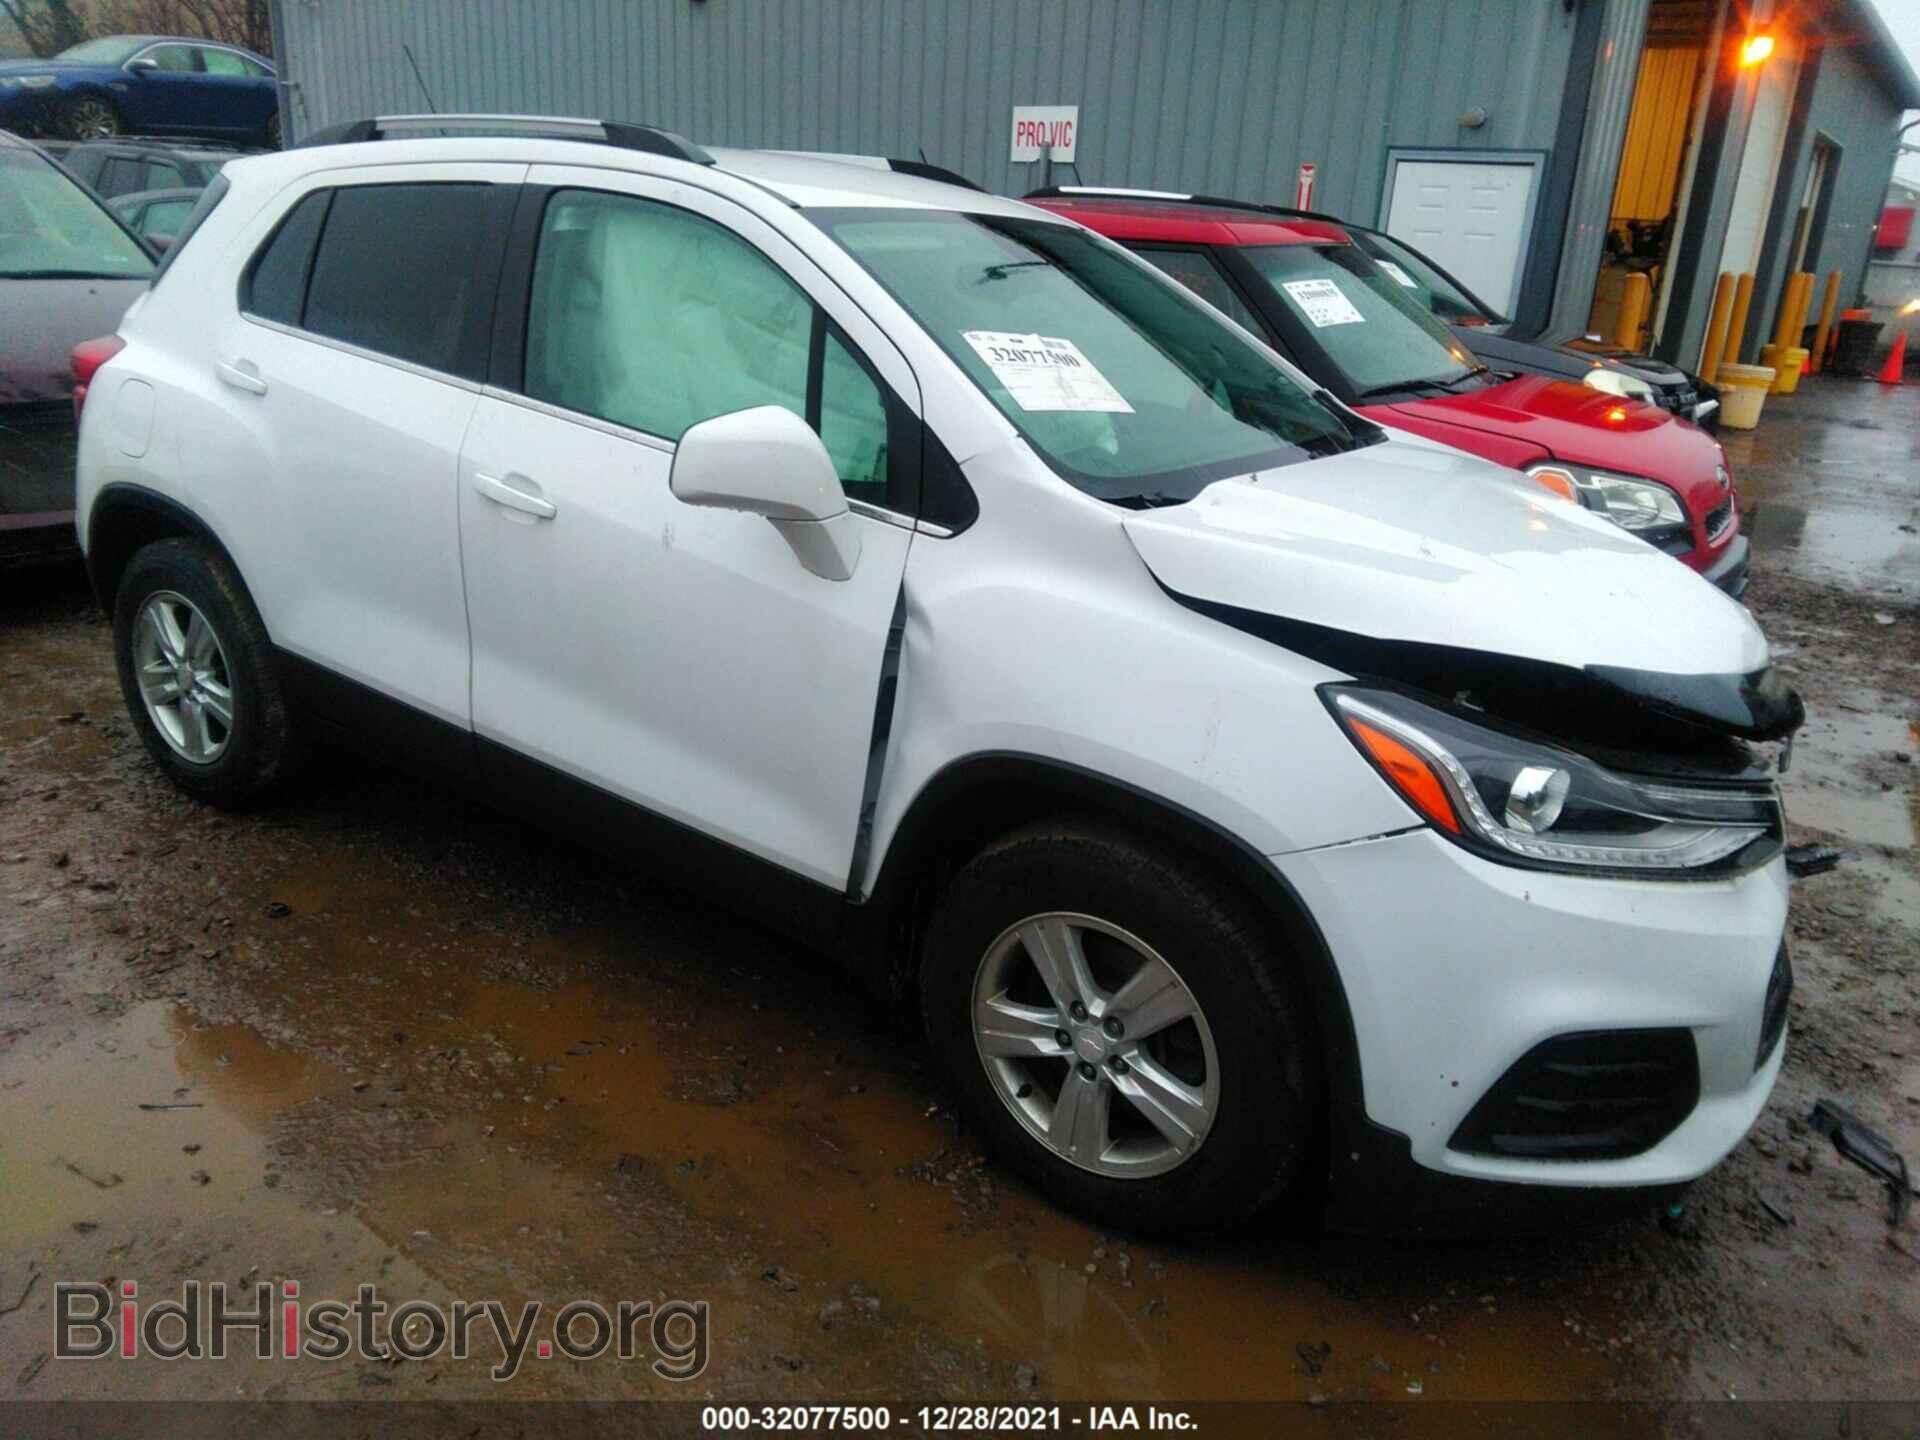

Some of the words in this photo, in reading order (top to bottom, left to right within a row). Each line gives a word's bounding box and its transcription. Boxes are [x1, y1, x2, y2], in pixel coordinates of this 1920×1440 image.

[1016, 120, 1045, 148] PRO
[1050, 120, 1073, 148] VIC
[987, 346, 1081, 368] 32077500
